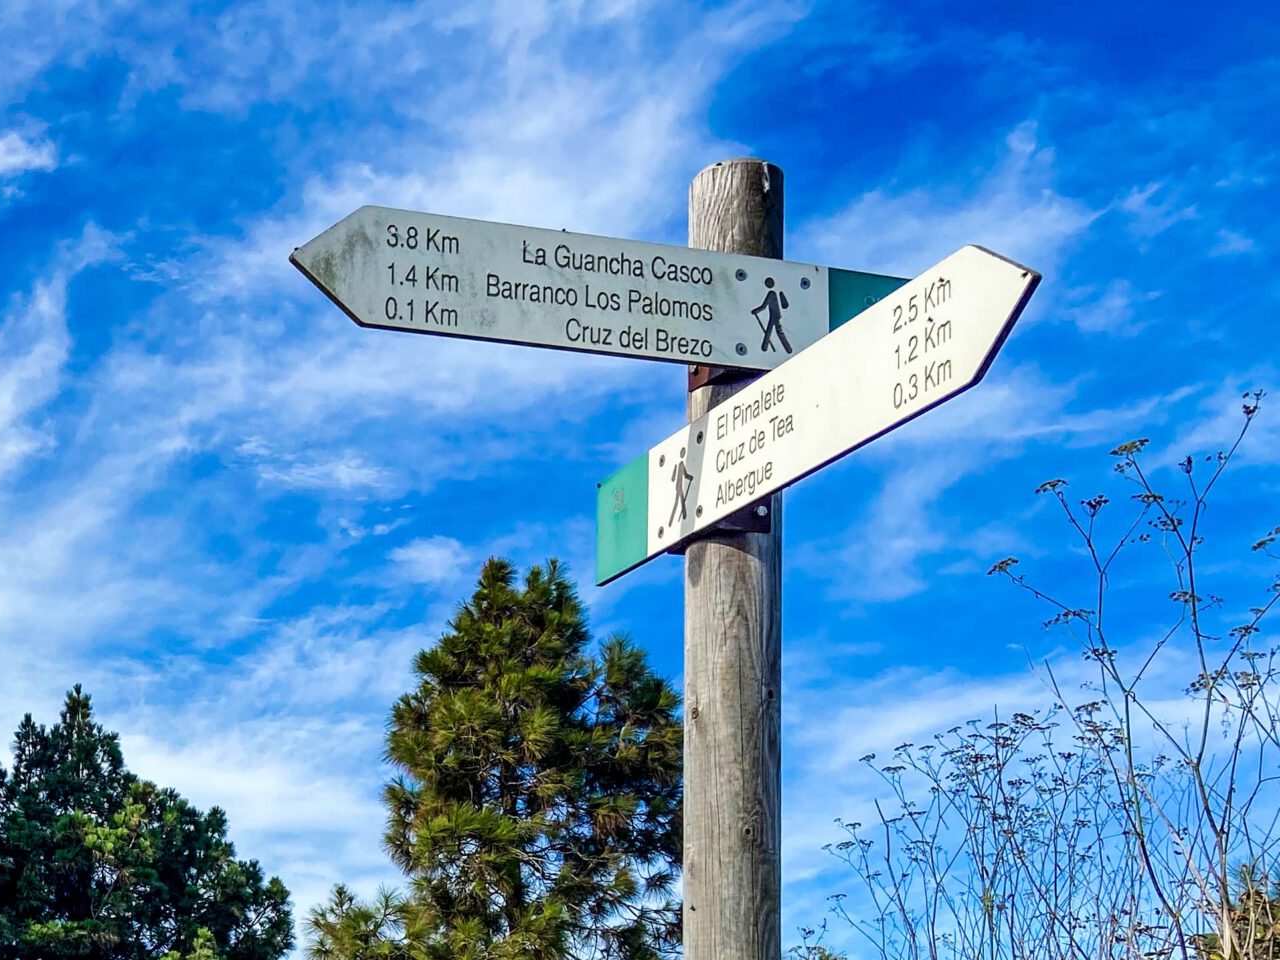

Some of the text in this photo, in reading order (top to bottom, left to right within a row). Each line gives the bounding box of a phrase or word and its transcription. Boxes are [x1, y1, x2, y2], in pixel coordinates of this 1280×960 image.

[386, 224, 459, 254] 3.8 Km
[522, 240, 713, 285] La Guancha Casco
[387, 262, 459, 293] 1.4 Km
[486, 273, 713, 321] Barranco Los Palomos
[385, 296, 458, 327] 0.1 Km
[893, 280, 951, 334] 2.5 Km
[566, 318, 713, 357] Cruz del Brezo
[894, 320, 951, 370] 1.2 Km
[893, 359, 952, 409] 0.3 Km
[717, 384, 785, 441] El Pinalete
[716, 414, 794, 473] Cruz de Tea
[715, 461, 773, 509] Albergue
